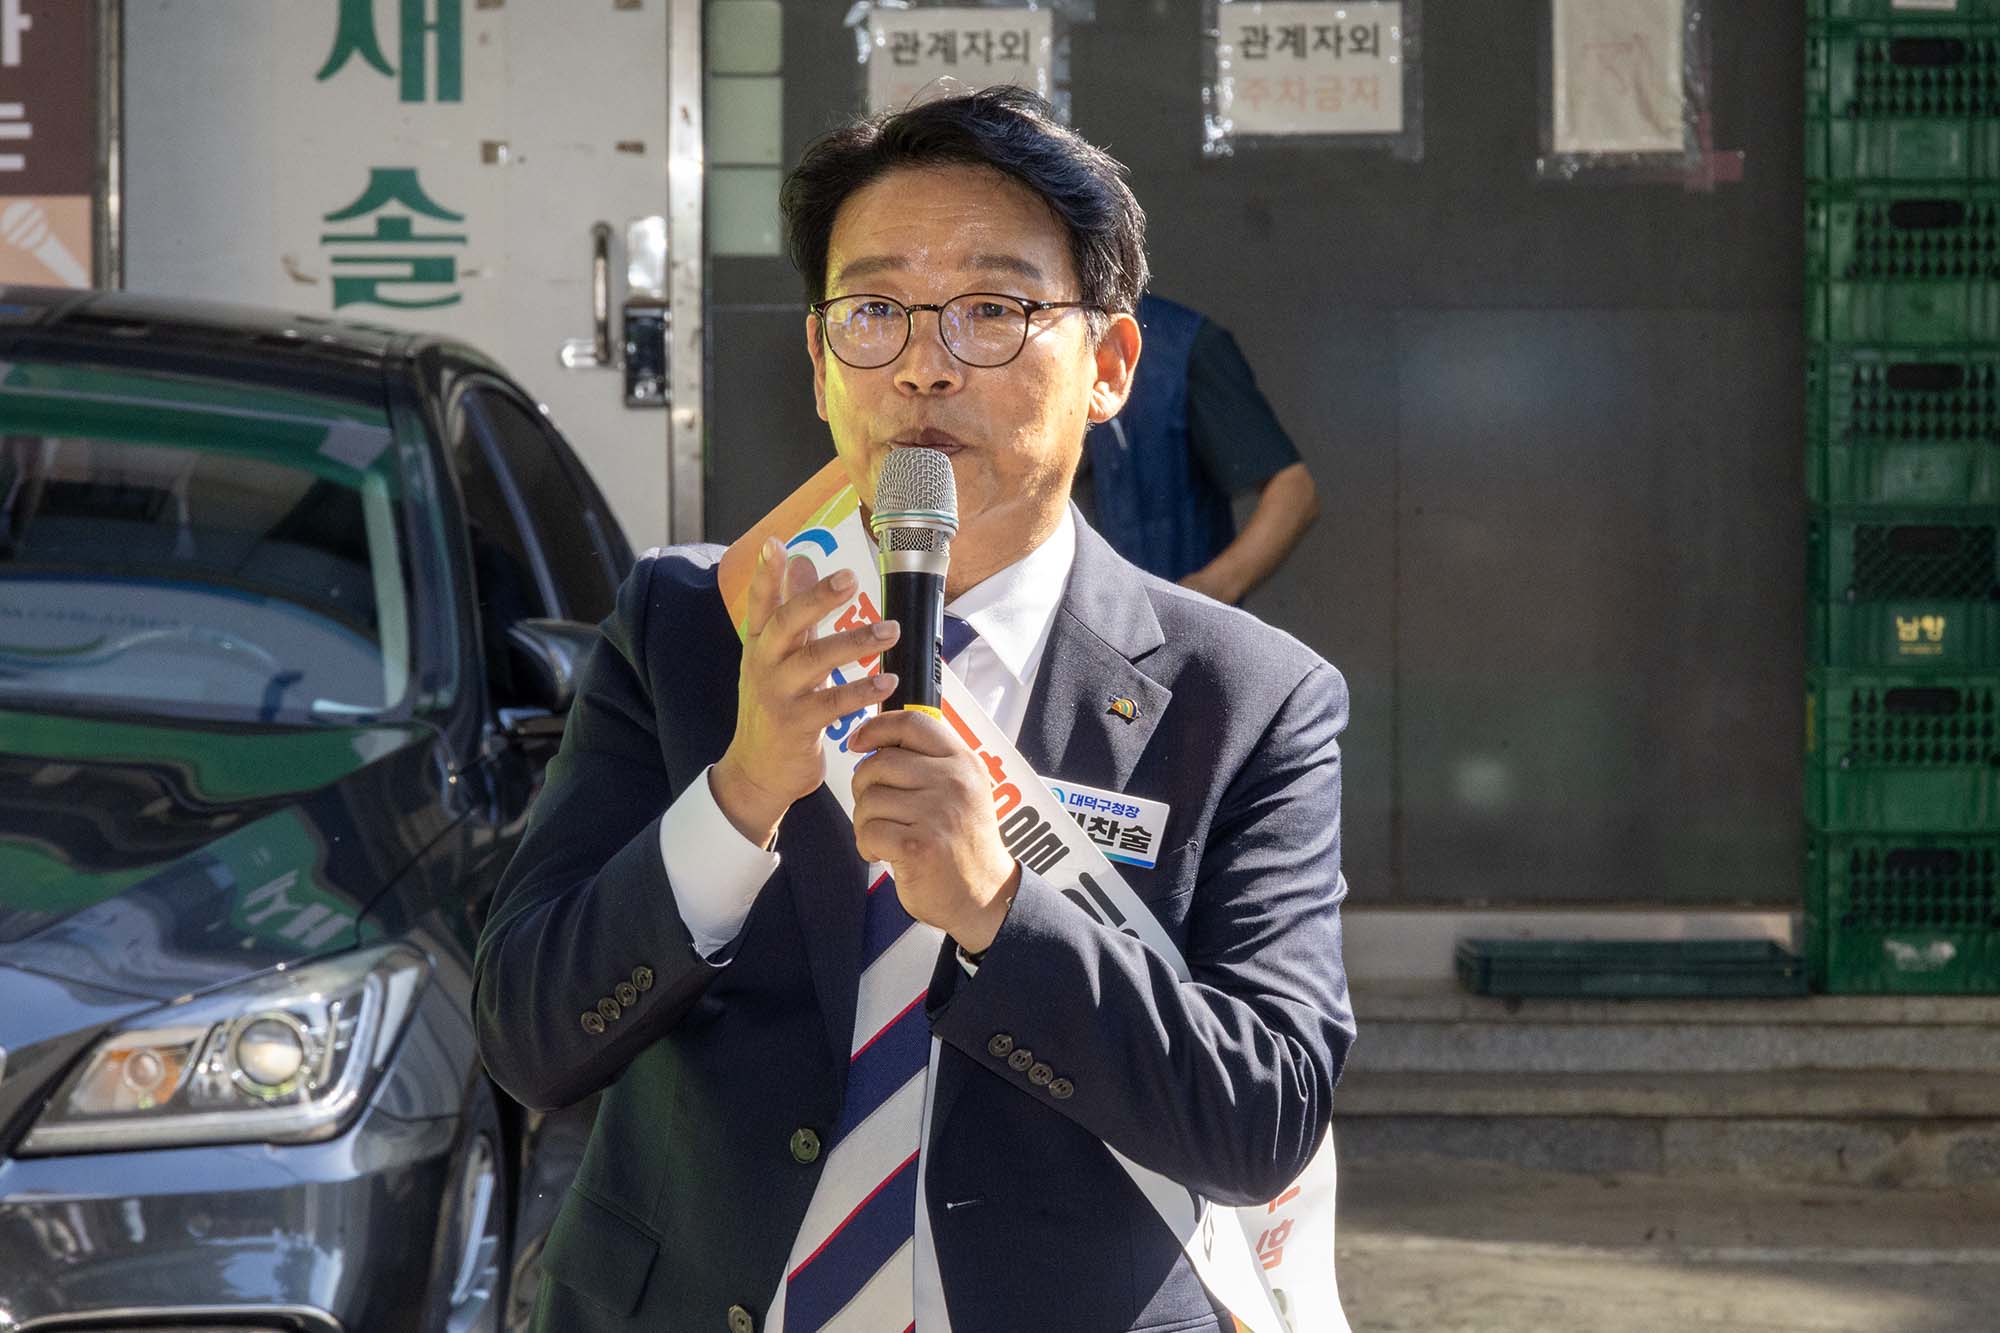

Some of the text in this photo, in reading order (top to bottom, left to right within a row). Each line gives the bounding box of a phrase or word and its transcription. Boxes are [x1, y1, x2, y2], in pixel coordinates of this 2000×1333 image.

[889, 29, 1032, 67] 관계자외
[1237, 22, 1381, 60] 관계자외
[1240, 74, 1380, 113] 주차금지
[1069, 793, 1141, 819] 대덕구청장
